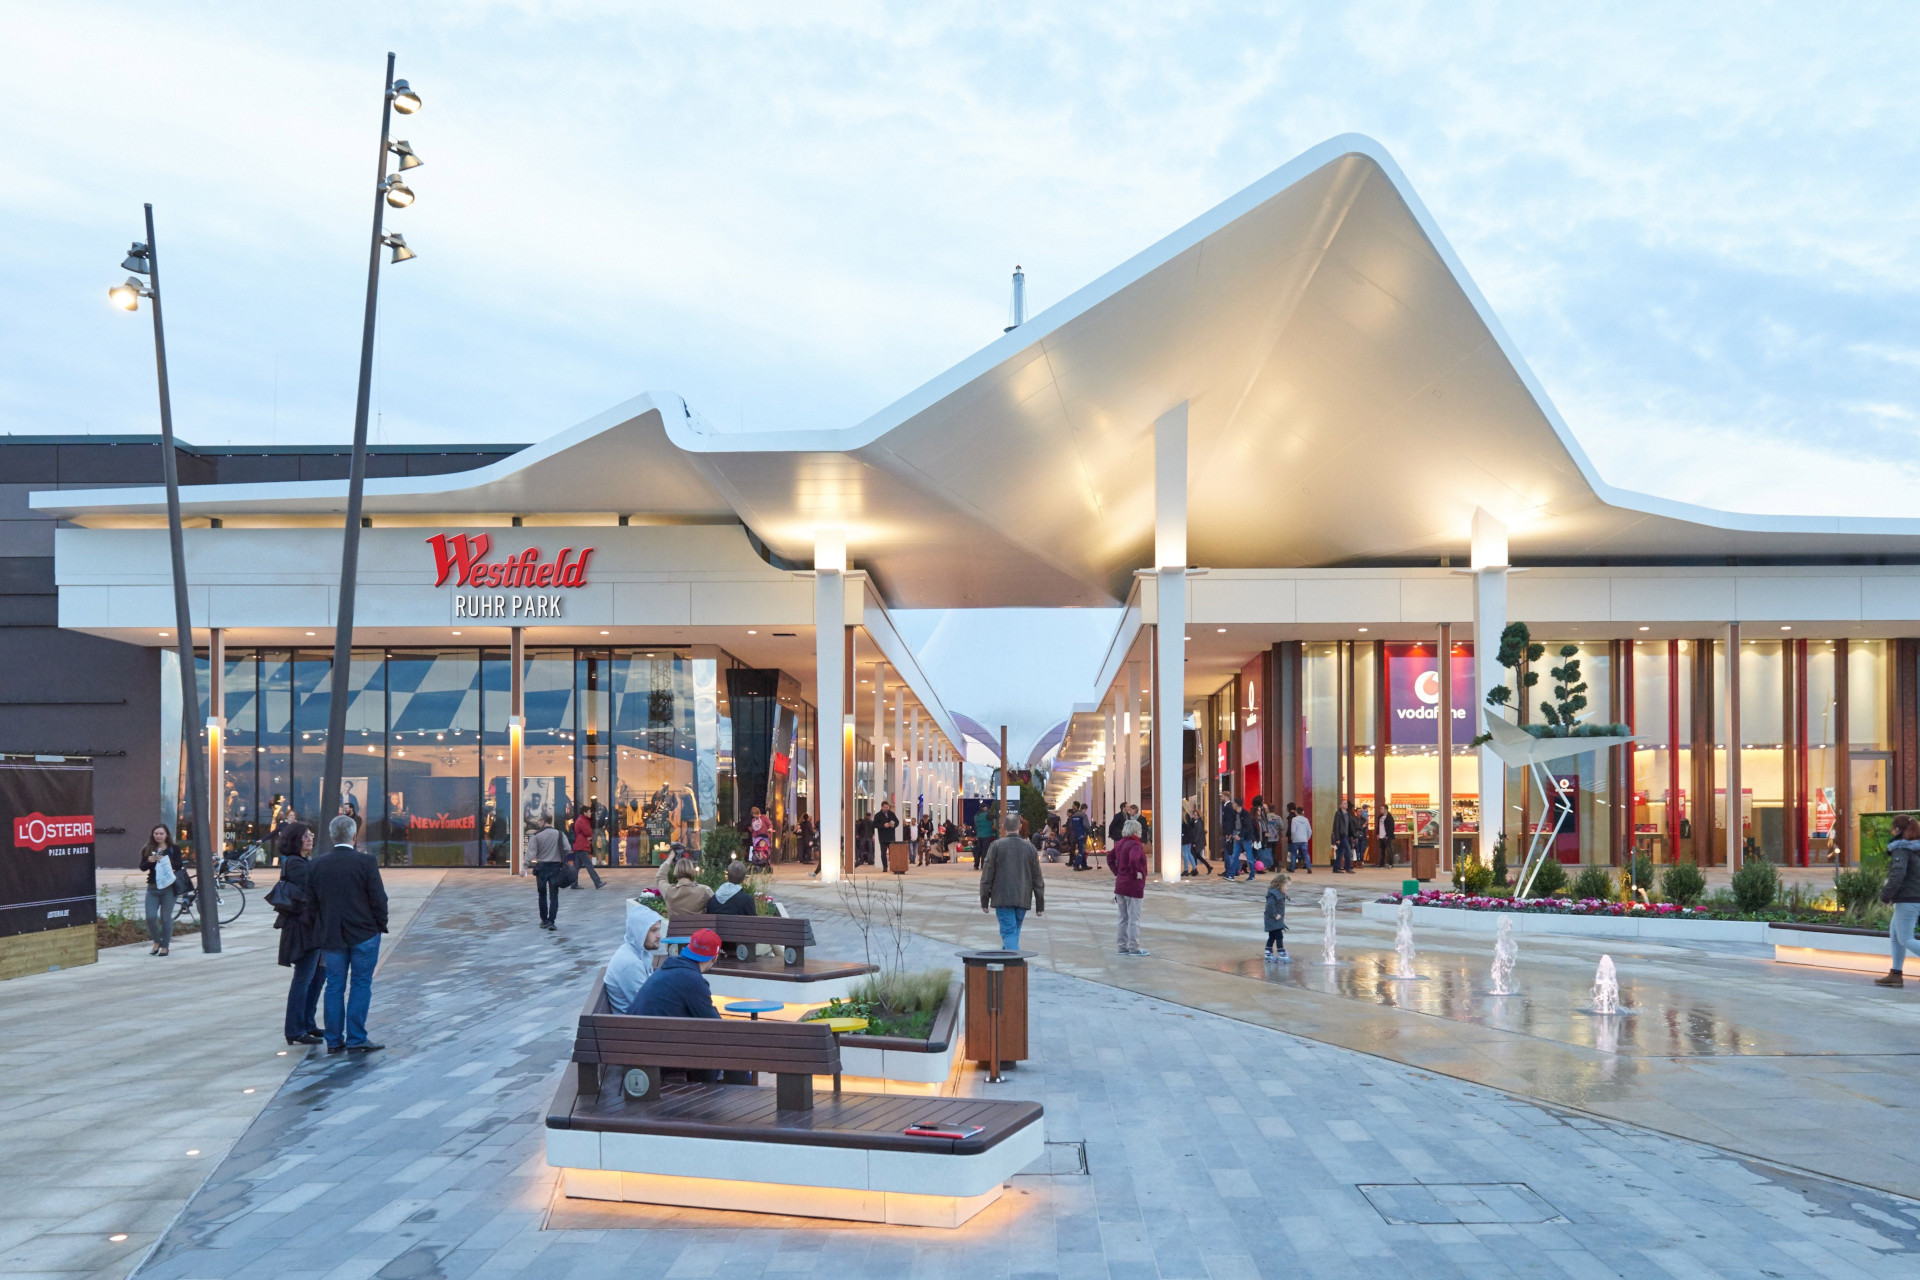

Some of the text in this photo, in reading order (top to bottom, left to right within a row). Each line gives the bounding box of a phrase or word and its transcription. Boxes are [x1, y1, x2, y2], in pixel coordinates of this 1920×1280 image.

[425, 532, 594, 588] Westfield
[455, 595, 562, 618] RUHR PARK
[1397, 706, 1466, 719] vodafne
[19, 820, 92, 843] L'OSTERIA
[48, 846, 89, 857] PIZZA E PASTA
